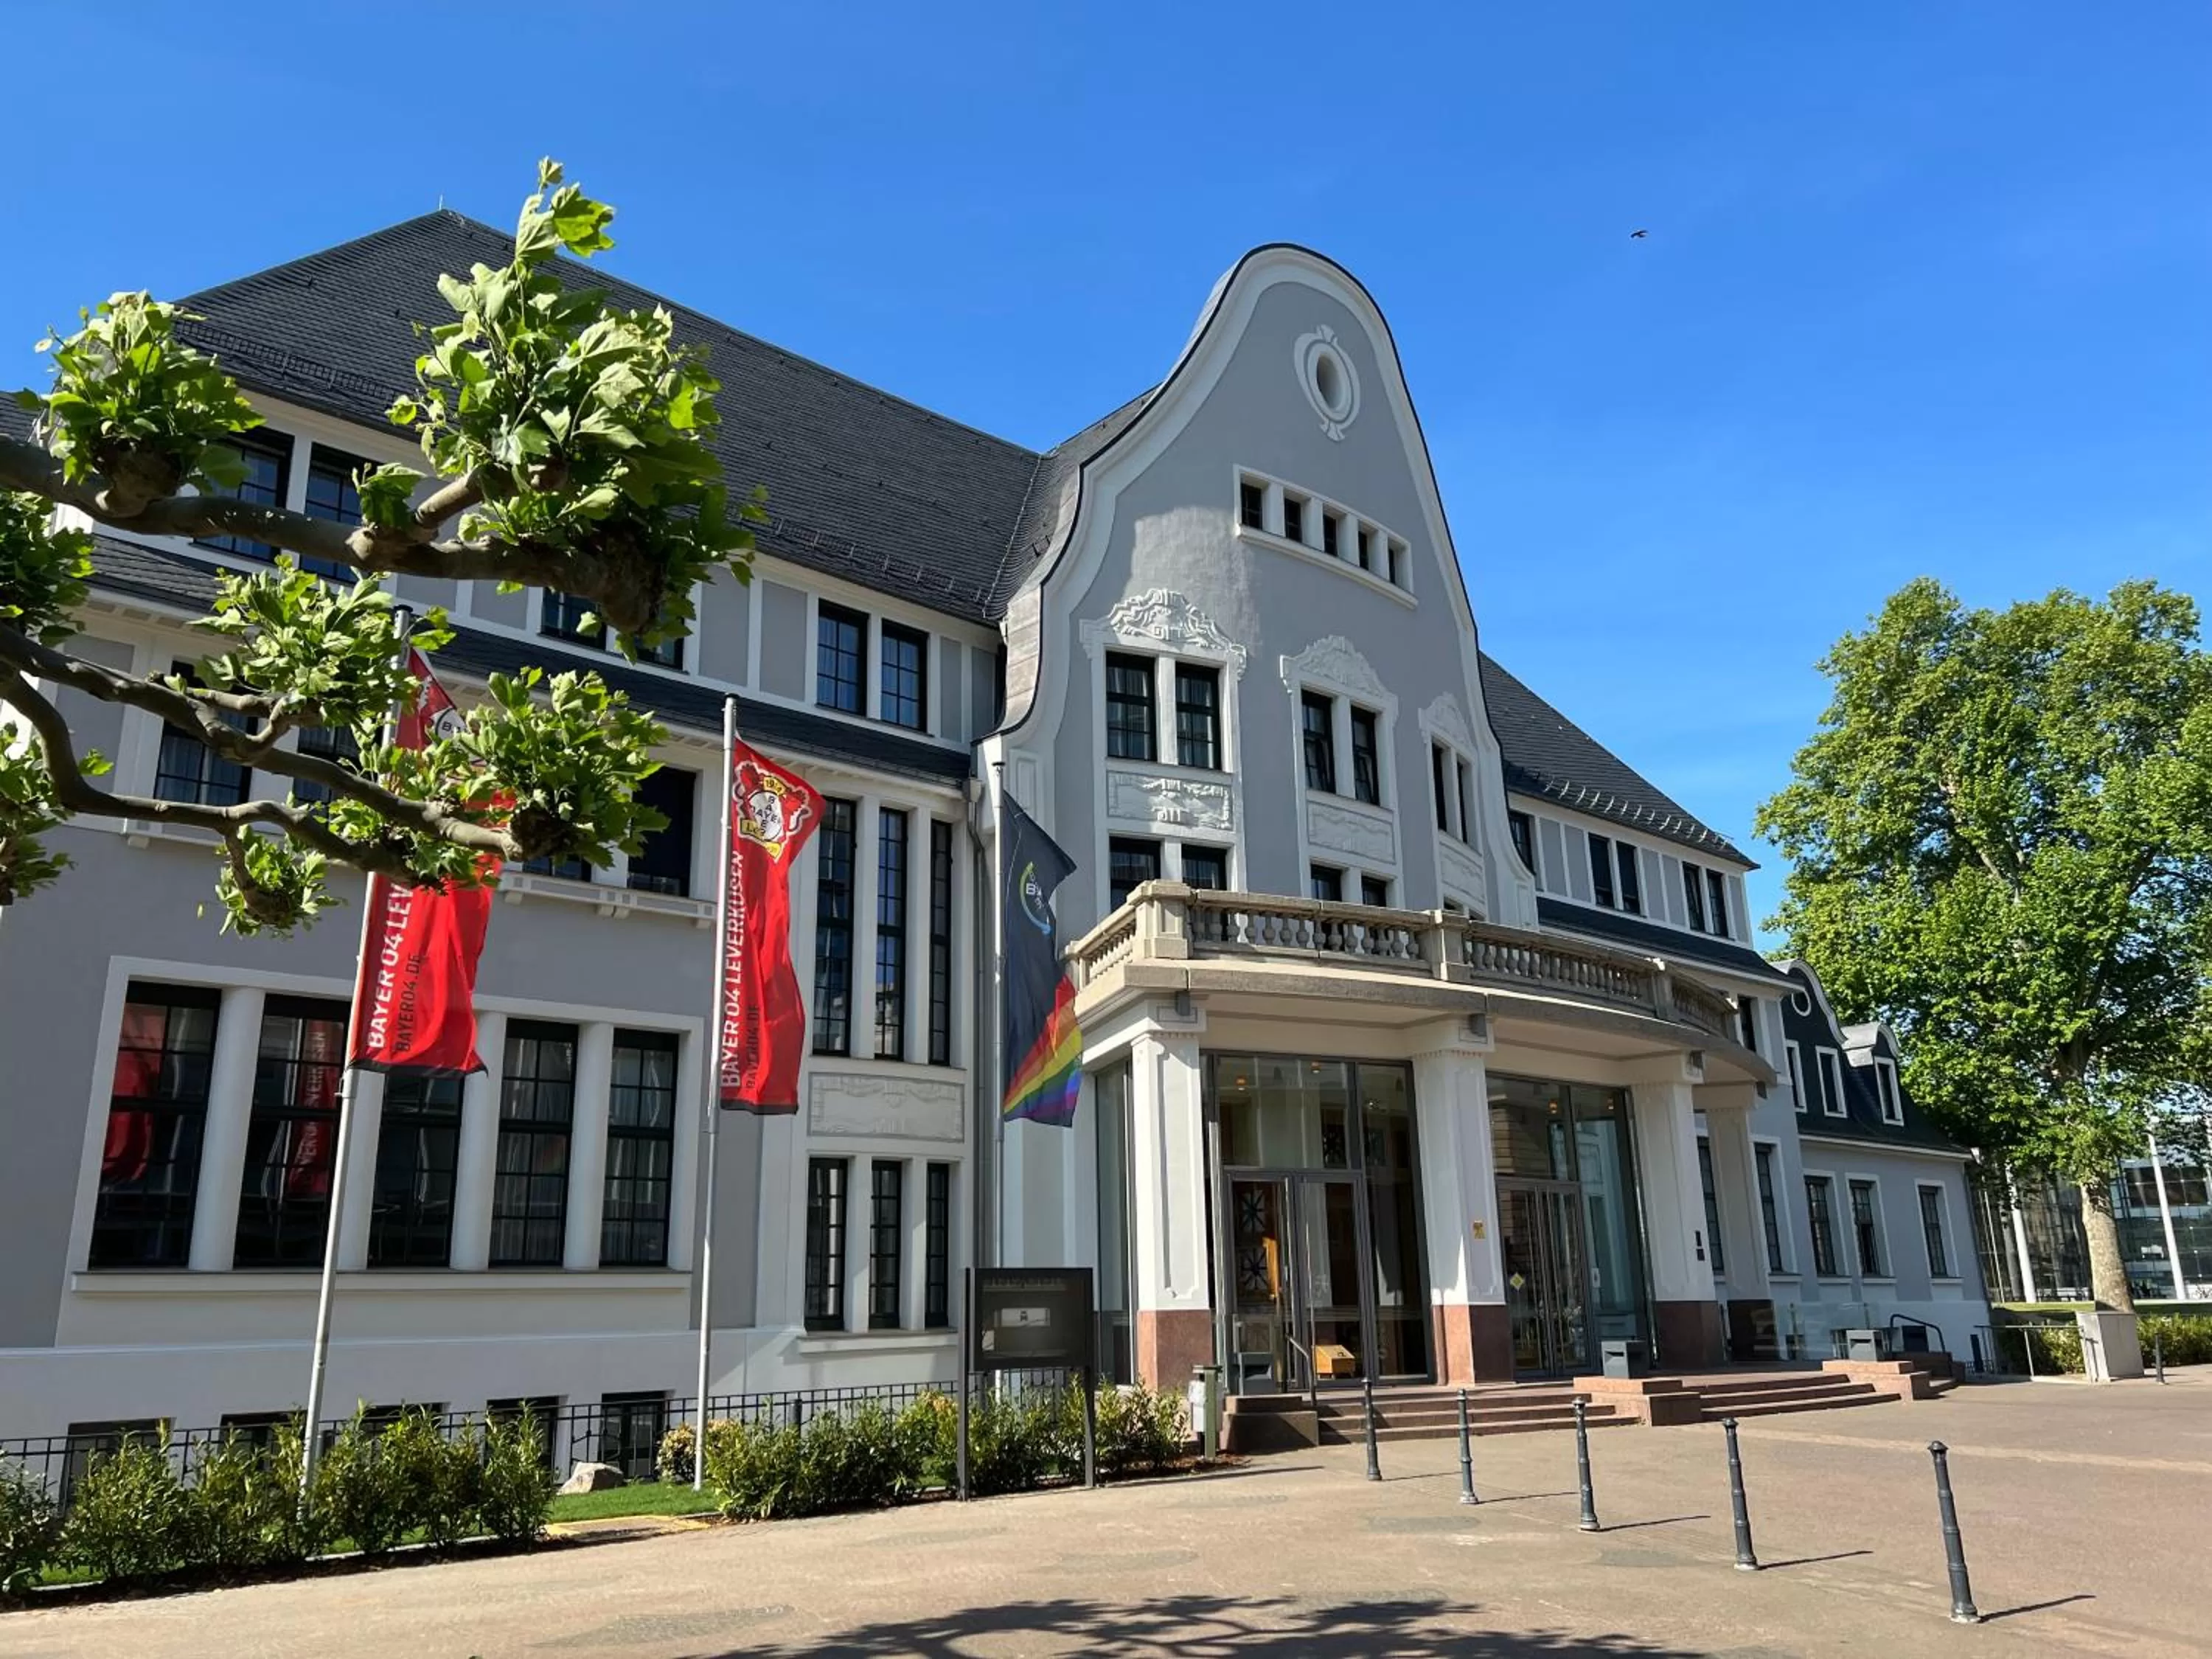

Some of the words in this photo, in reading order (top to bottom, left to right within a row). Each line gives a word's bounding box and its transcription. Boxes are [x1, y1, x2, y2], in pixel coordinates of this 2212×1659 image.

[380, 933, 404, 967] 04
[726, 850, 745, 984] LEVERKUSEN
[369, 970, 395, 1048] BAYER
[395, 953, 421, 1051] BAYER04.DE
[725, 989, 740, 1017] 04
[721, 1020, 740, 1088] BAYER
